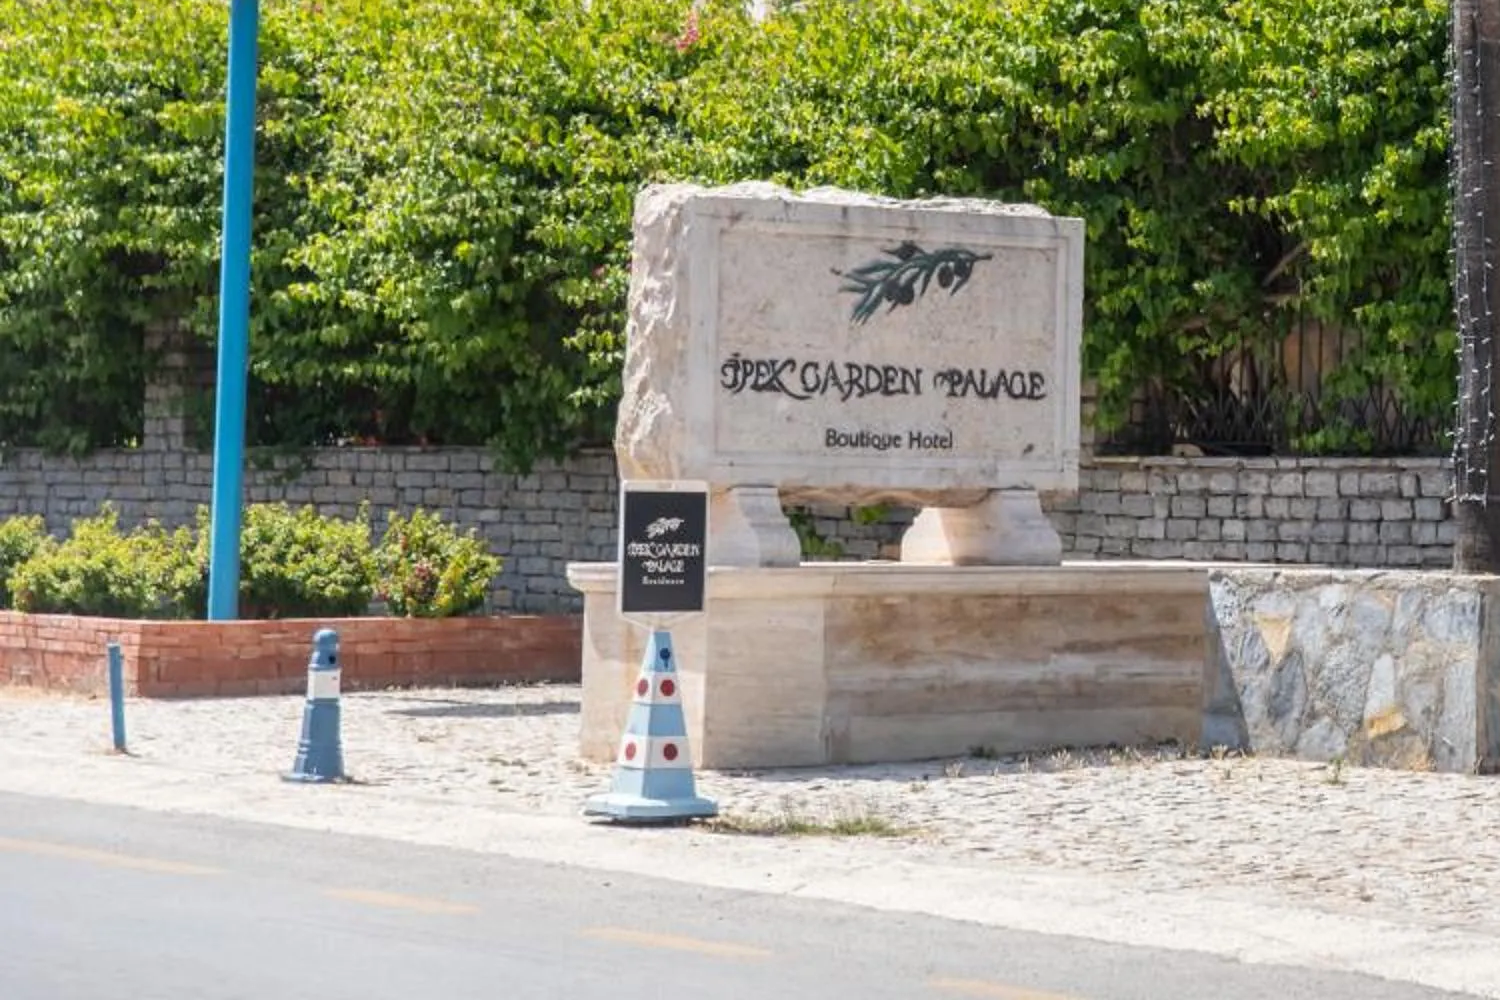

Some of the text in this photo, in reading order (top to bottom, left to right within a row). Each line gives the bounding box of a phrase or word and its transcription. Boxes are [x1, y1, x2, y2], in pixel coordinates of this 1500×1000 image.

[800, 361, 923, 402] GARDEN
[932, 369, 1047, 400] PALACE
[824, 428, 954, 451] Boutique Hotel
